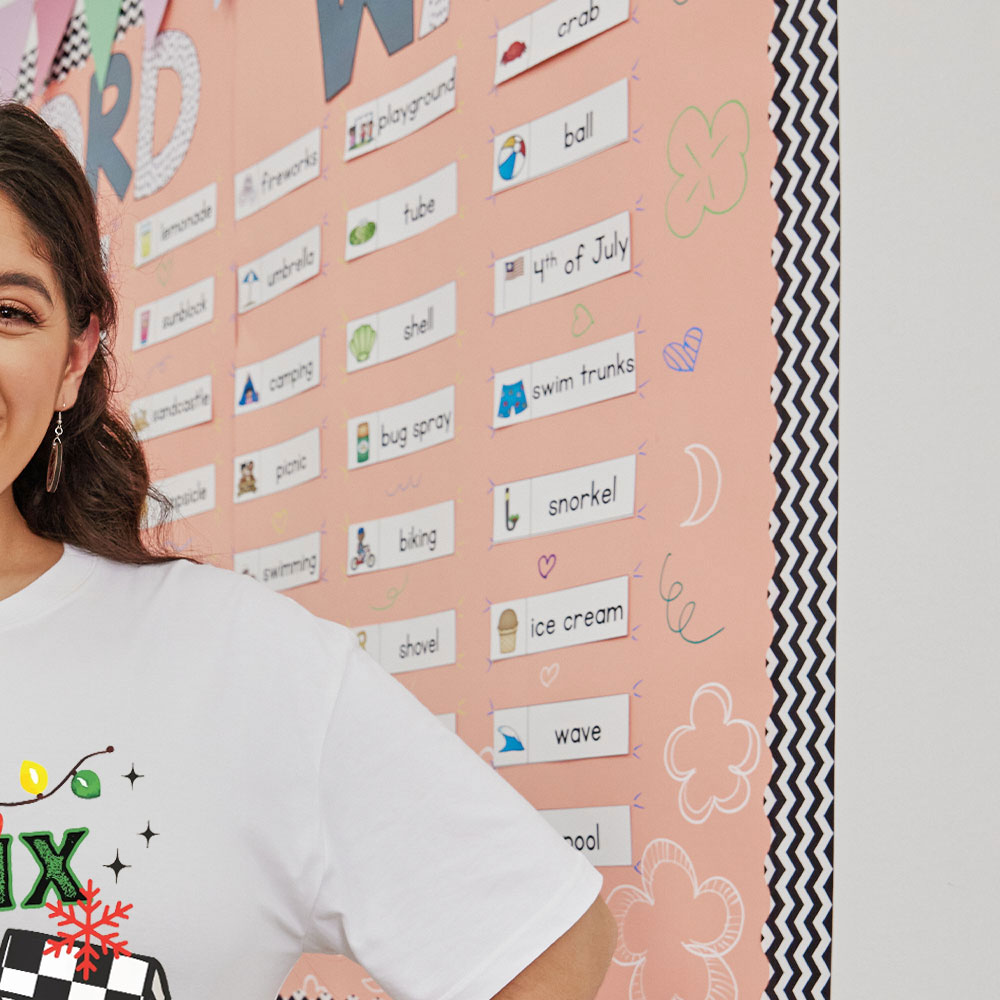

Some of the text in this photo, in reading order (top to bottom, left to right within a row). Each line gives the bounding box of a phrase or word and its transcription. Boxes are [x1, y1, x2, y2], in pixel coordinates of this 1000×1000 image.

[557, 0, 600, 38] crab
[378, 66, 457, 136] playground
[564, 111, 594, 148] ball
[261, 147, 318, 193] fireworks
[160, 201, 213, 242] lemonade
[404, 194, 436, 225] tube
[267, 246, 315, 288] umbrella
[564, 243, 585, 275] of
[592, 230, 629, 265] July
[162, 293, 208, 330] sunblock
[404, 305, 434, 341] shell
[269, 361, 314, 393] camping
[532, 352, 635, 400] swim trunks
[153, 387, 209, 422] sandcastle
[381, 410, 452, 449] bug spray
[276, 454, 308, 485] picnic
[548, 475, 617, 517] snorkel
[399, 526, 437, 552] biking
[263, 554, 317, 582] swimming
[531, 604, 624, 638] ice cream
[399, 627, 440, 659] shovel
[554, 724, 602, 745] wave
